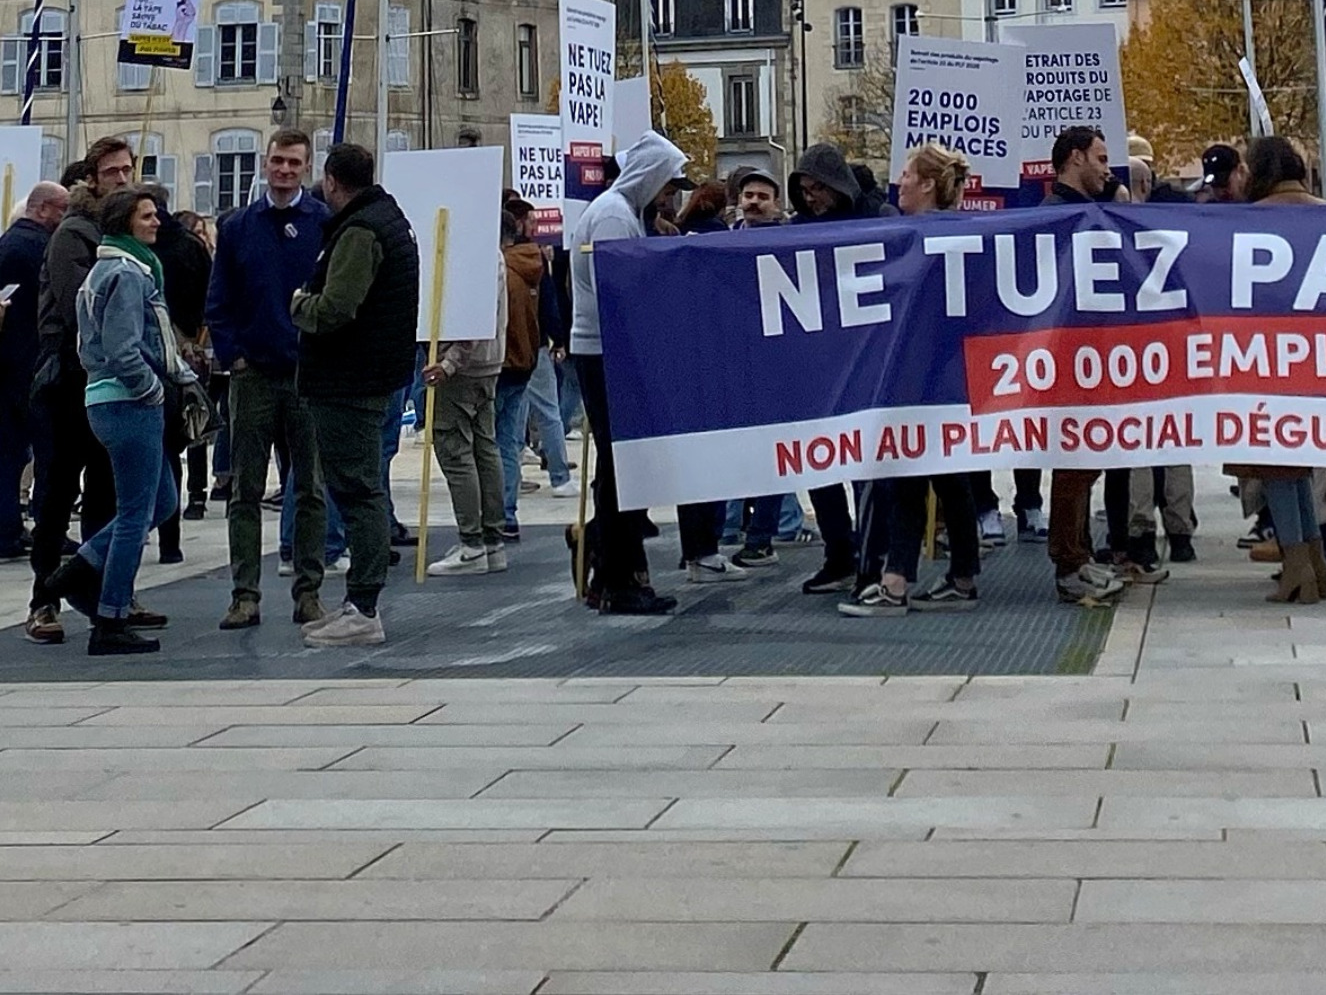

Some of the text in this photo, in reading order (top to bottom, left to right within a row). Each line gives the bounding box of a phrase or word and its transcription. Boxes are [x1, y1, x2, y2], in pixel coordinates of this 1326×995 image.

[568, 43, 611, 75] NE TUEZ
[1025, 52, 1100, 67] ETRAIT DES
[1026, 70, 1108, 85] RODUITS DU
[569, 71, 605, 102] PAS LA
[908, 88, 978, 111] 20 000
[1024, 88, 1112, 103] APOTAGE DE
[569, 99, 598, 128] VAPE
[1022, 106, 1102, 121] 'ARTICLE 23
[907, 110, 1000, 135] EMPLOIS
[1021, 125, 1040, 139] DU
[520, 147, 562, 163] NE TUE
[520, 165, 562, 180] PAS LA
[1025, 163, 1057, 175] VAPE
[520, 183, 552, 198] VAPE
[756, 242, 892, 337] NE
[923, 229, 1189, 317] TUEZ
[991, 348, 1056, 397] 20
[1074, 341, 1170, 389] 000
[776, 429, 863, 477] NON
[876, 424, 927, 462] AU
[941, 416, 1049, 457] PLAN
[1060, 413, 1203, 453] SOCIAL
